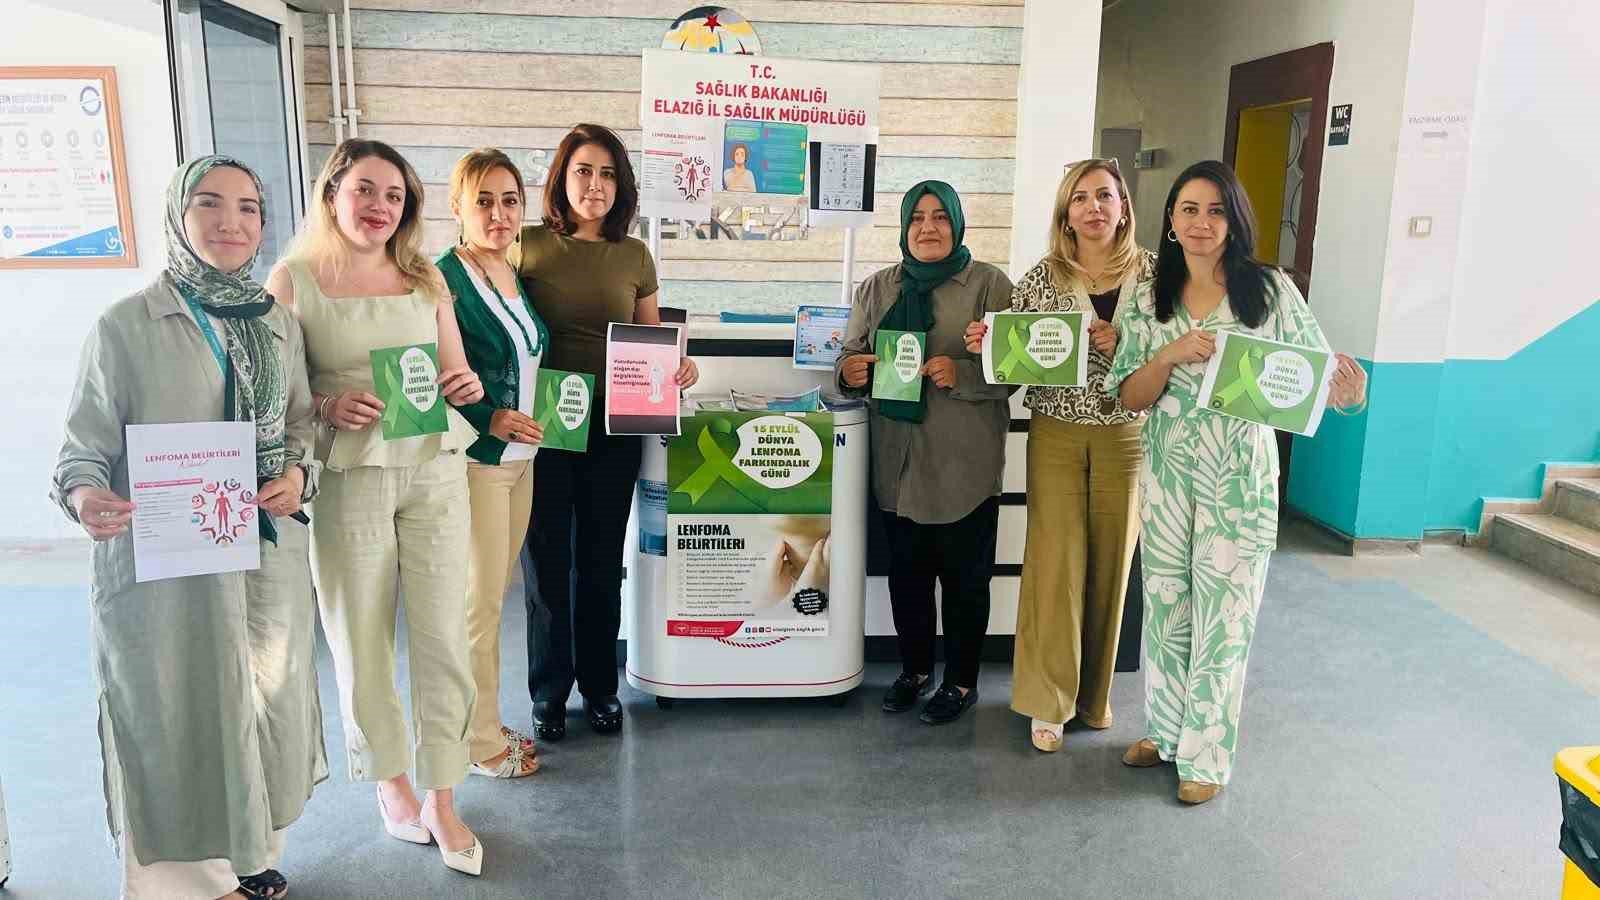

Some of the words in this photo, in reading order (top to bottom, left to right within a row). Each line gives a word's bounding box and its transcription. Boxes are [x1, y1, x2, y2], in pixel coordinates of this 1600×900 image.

[750, 64, 776, 80] T.C.
[695, 80, 747, 98] SAĞLIK
[751, 84, 827, 104] BAKANLIĞI
[654, 99, 704, 116] ELAZIĞ
[707, 101, 720, 117] İL
[724, 102, 775, 121] SAĞLIK
[779, 104, 866, 126] MÜDÜRLÜĞÜ
[1335, 106, 1349, 120] WC
[753, 425, 767, 433] 15
[769, 423, 800, 434] EYLÜL
[758, 434, 795, 445] DÜNYA
[144, 452, 190, 463] LENFOMA
[191, 447, 241, 460] BELİRTİLERİ
[751, 447, 801, 456] LENFOMA
[739, 458, 810, 468] FARKINDALIK
[760, 469, 791, 478] GÜNÜ
[677, 524, 731, 536] LENFOMA
[677, 537, 745, 550] BELİRTİLERİ
